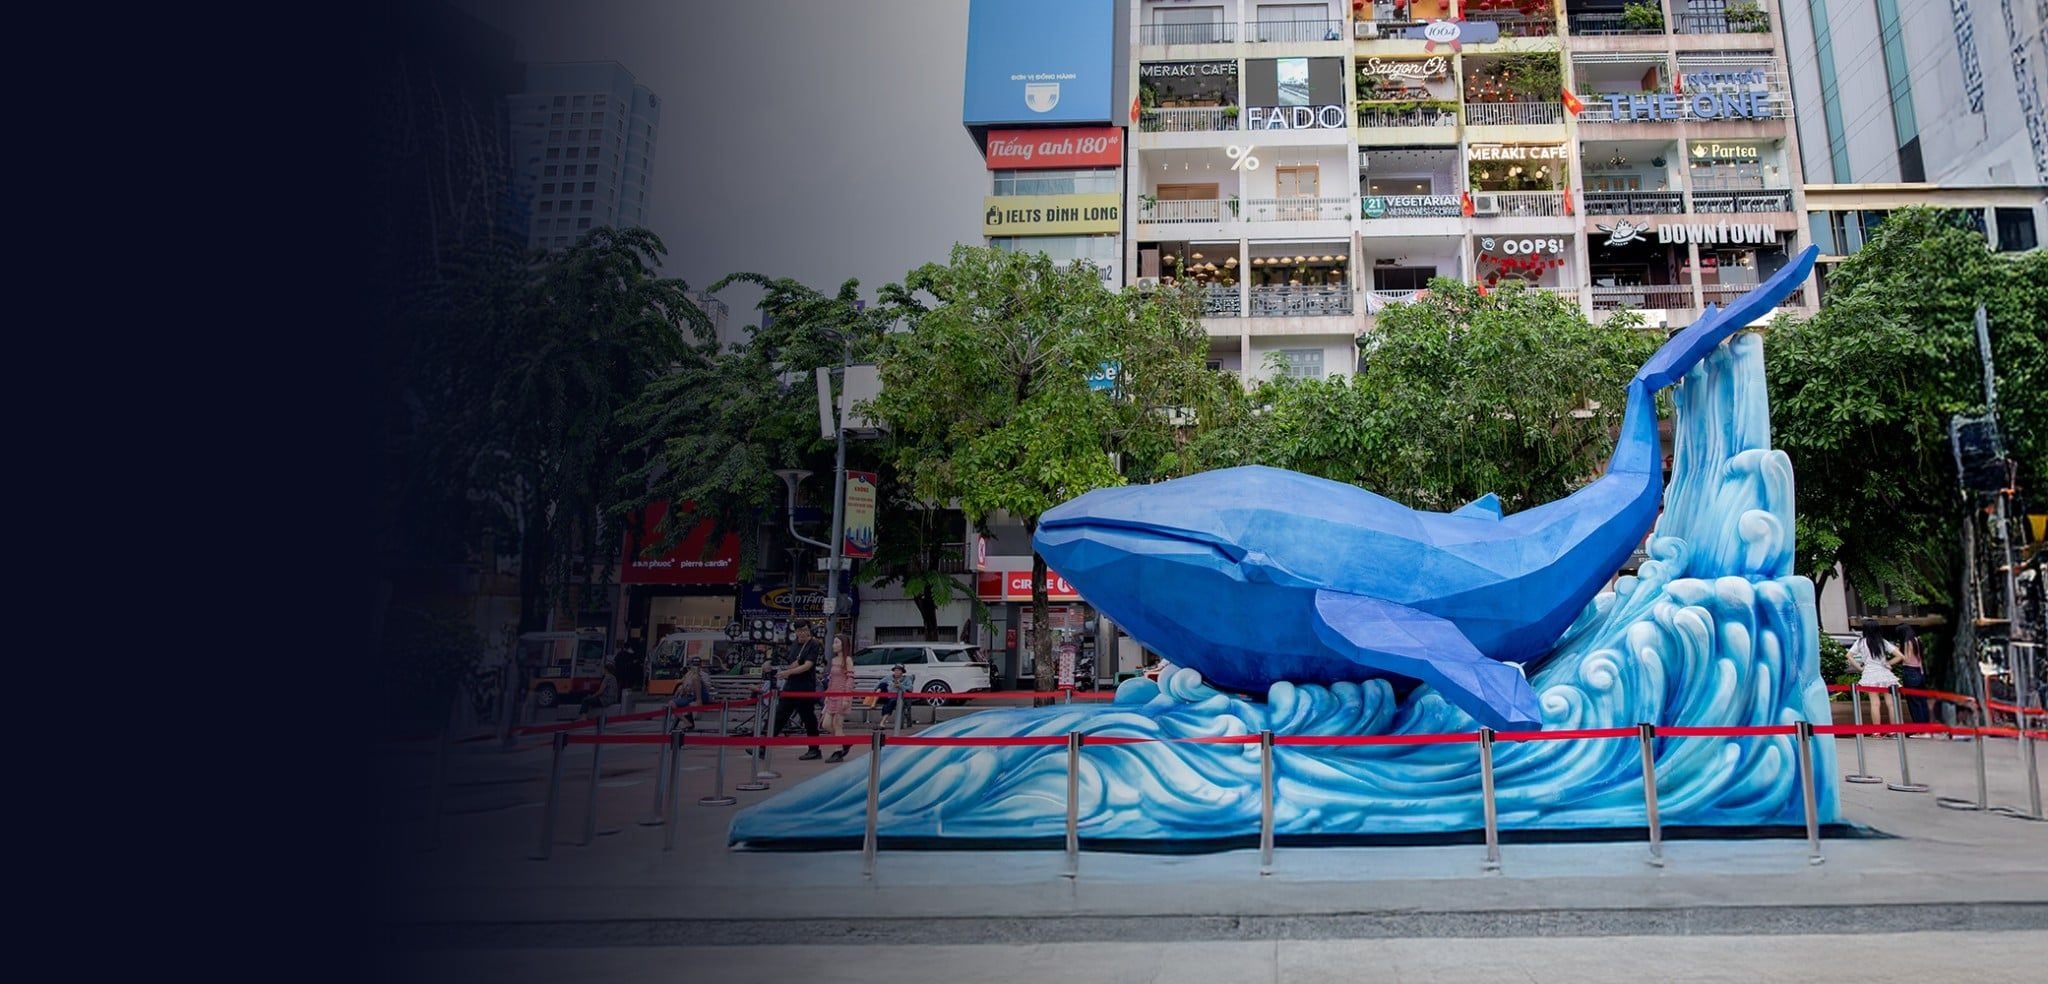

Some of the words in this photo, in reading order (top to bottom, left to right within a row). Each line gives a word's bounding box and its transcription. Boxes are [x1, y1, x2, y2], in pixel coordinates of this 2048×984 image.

[1140, 64, 1196, 77] MERAKI
[1199, 60, 1238, 76] CAFÉ
[1362, 57, 1423, 80] Saigon
[1602, 91, 1680, 121] THE
[1691, 90, 1772, 119] ONE
[1247, 105, 1345, 129] FADO
[989, 137, 1034, 160] Tiếng
[1038, 140, 1073, 155] anh
[1075, 137, 1108, 155] 180
[1468, 147, 1527, 160] MERAKI
[1529, 143, 1568, 159] CAFÉ
[1711, 144, 1758, 157] Partea
[1368, 198, 1381, 209] 21
[1386, 196, 1460, 206] VEGETARIAN
[1006, 209, 1042, 223] IELTS
[1046, 206, 1079, 222] ĐÌNH
[1083, 207, 1118, 221] LONG
[1657, 219, 1776, 244] DOWNTOWN
[1503, 239, 1564, 255] OOPS!
[1012, 577, 1054, 589] CIRE
